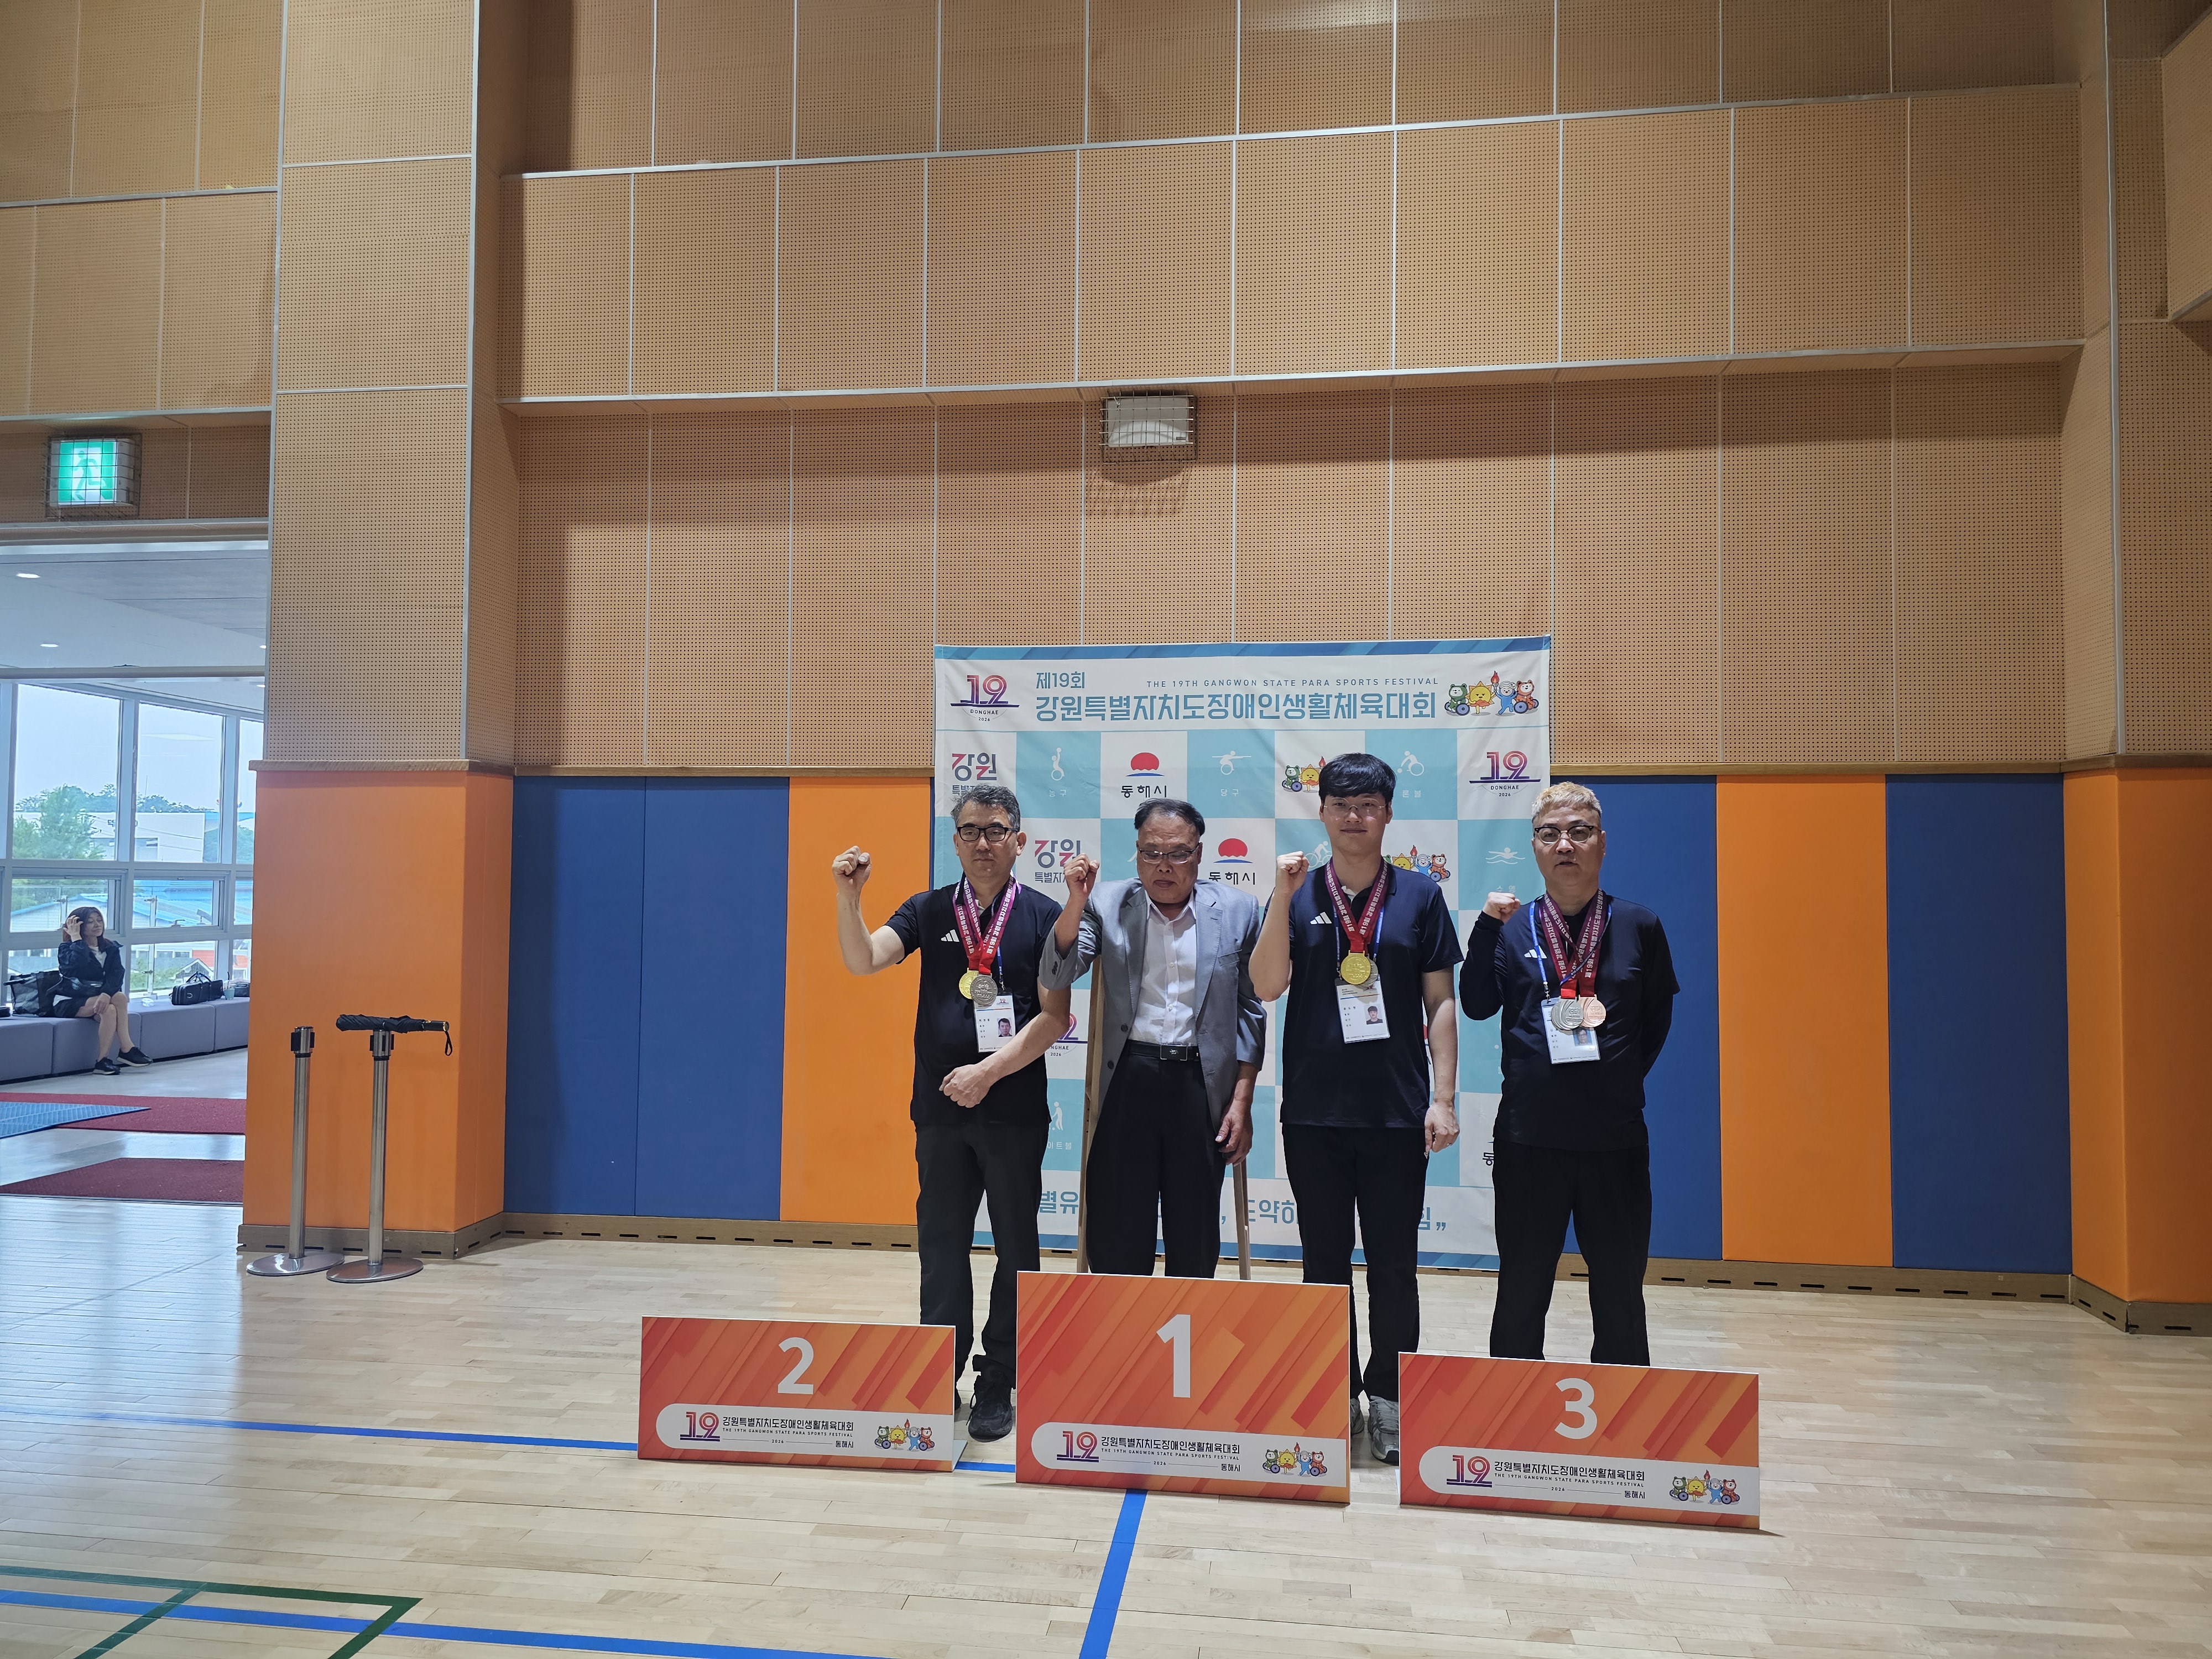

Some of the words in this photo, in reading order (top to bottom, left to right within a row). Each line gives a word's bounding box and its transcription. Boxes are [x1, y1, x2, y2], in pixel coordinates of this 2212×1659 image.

[1036, 671, 1085, 689] 제19회
[959, 675, 1009, 706] 19
[1036, 691, 1436, 722] 강원특별자치도장애인생활체육대회
[952, 752, 997, 781] 강원
[1479, 750, 1531, 781] 19
[1121, 785, 1167, 799] 동해시
[1220, 789, 1239, 797] 당구
[1035, 872, 1066, 883] 특별자
[1208, 872, 1255, 885] 동해시
[1047, 1141, 1072, 1150] 이트볼
[778, 1337, 814, 1395] 2
[1156, 1314, 1191, 1398] 1
[1554, 1377, 1598, 1439] 3
[680, 1411, 721, 1442] 19
[722, 1416, 854, 1432] 강원특별자치도장애인생활체육대회
[1057, 1431, 1099, 1463] 19
[1101, 1436, 1240, 1454] 강원특별자치도장애인생활체육대회
[1221, 1463, 1240, 1472] 동해시
[1446, 1454, 1493, 1488] 19
[1494, 1461, 1645, 1481] 강원특별자치도장애인생활체육대회
[1624, 1490, 1645, 1499] 동해시
